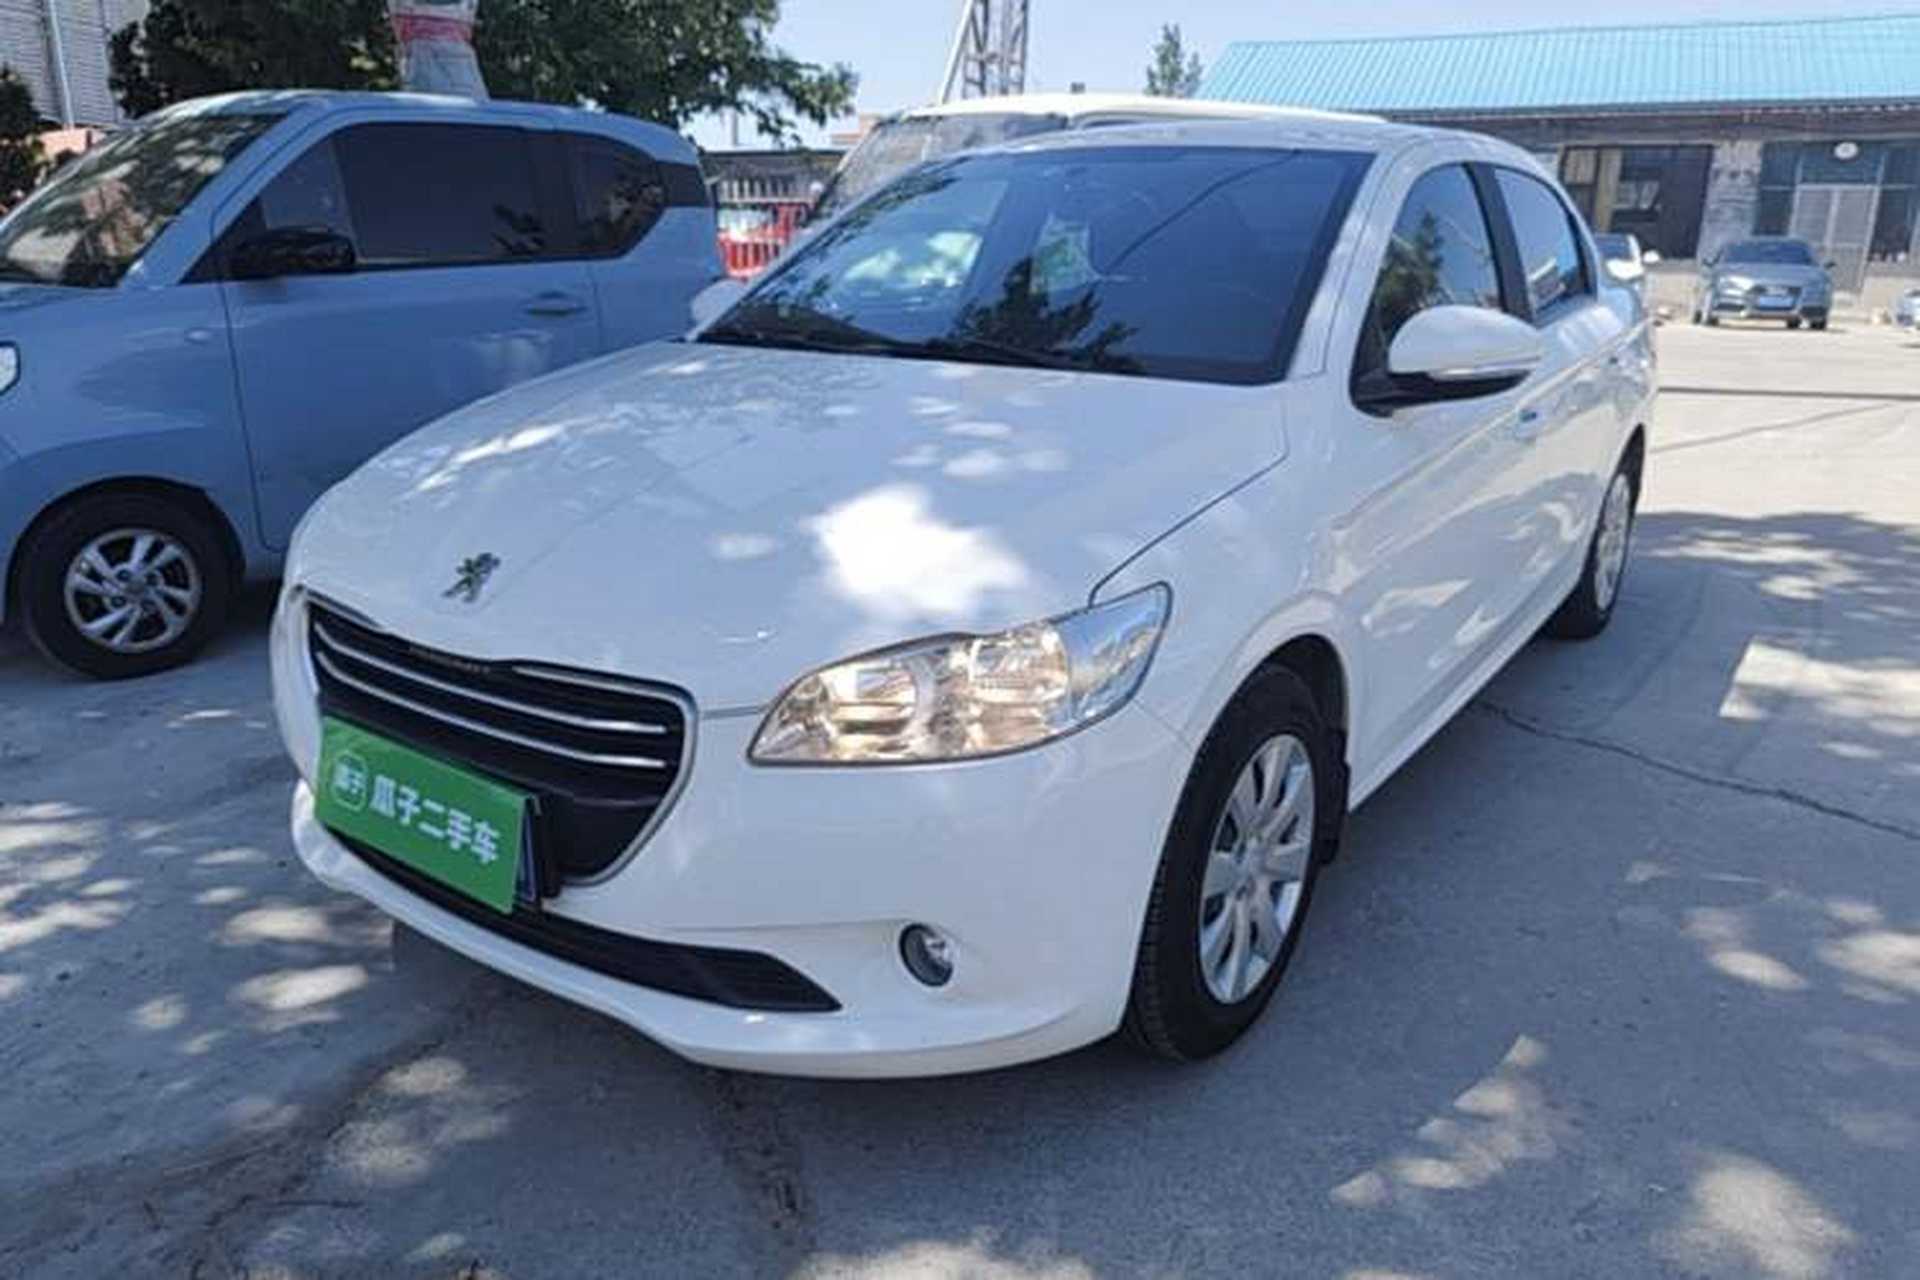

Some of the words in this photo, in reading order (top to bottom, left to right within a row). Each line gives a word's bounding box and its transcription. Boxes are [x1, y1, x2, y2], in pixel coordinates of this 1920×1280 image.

[368, 773, 499, 864] 瓜子二手车
